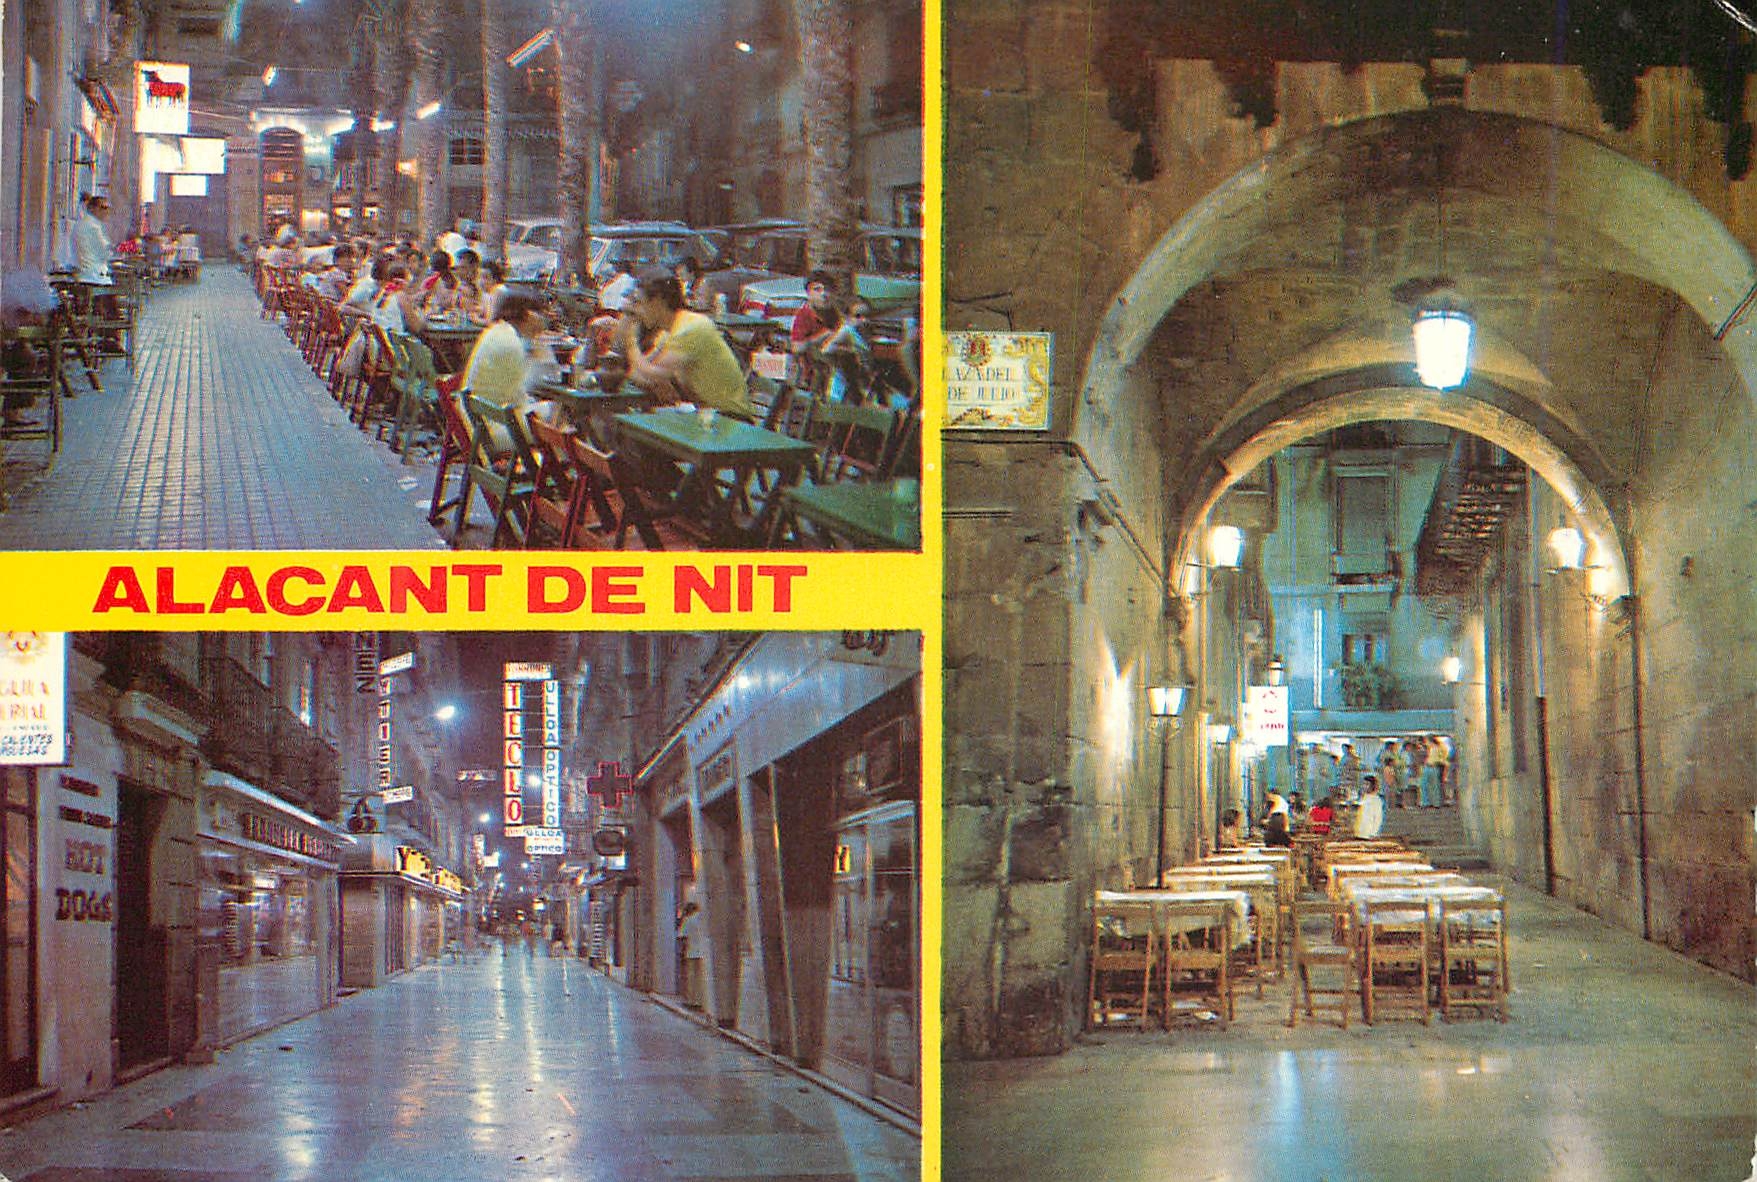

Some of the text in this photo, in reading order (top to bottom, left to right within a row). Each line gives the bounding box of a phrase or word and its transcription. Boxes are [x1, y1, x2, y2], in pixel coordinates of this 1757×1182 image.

[507, 684, 522, 822] TECLO
[545, 682, 556, 826] ULLOA OPTICO
[56, 887, 113, 922] DOGS
